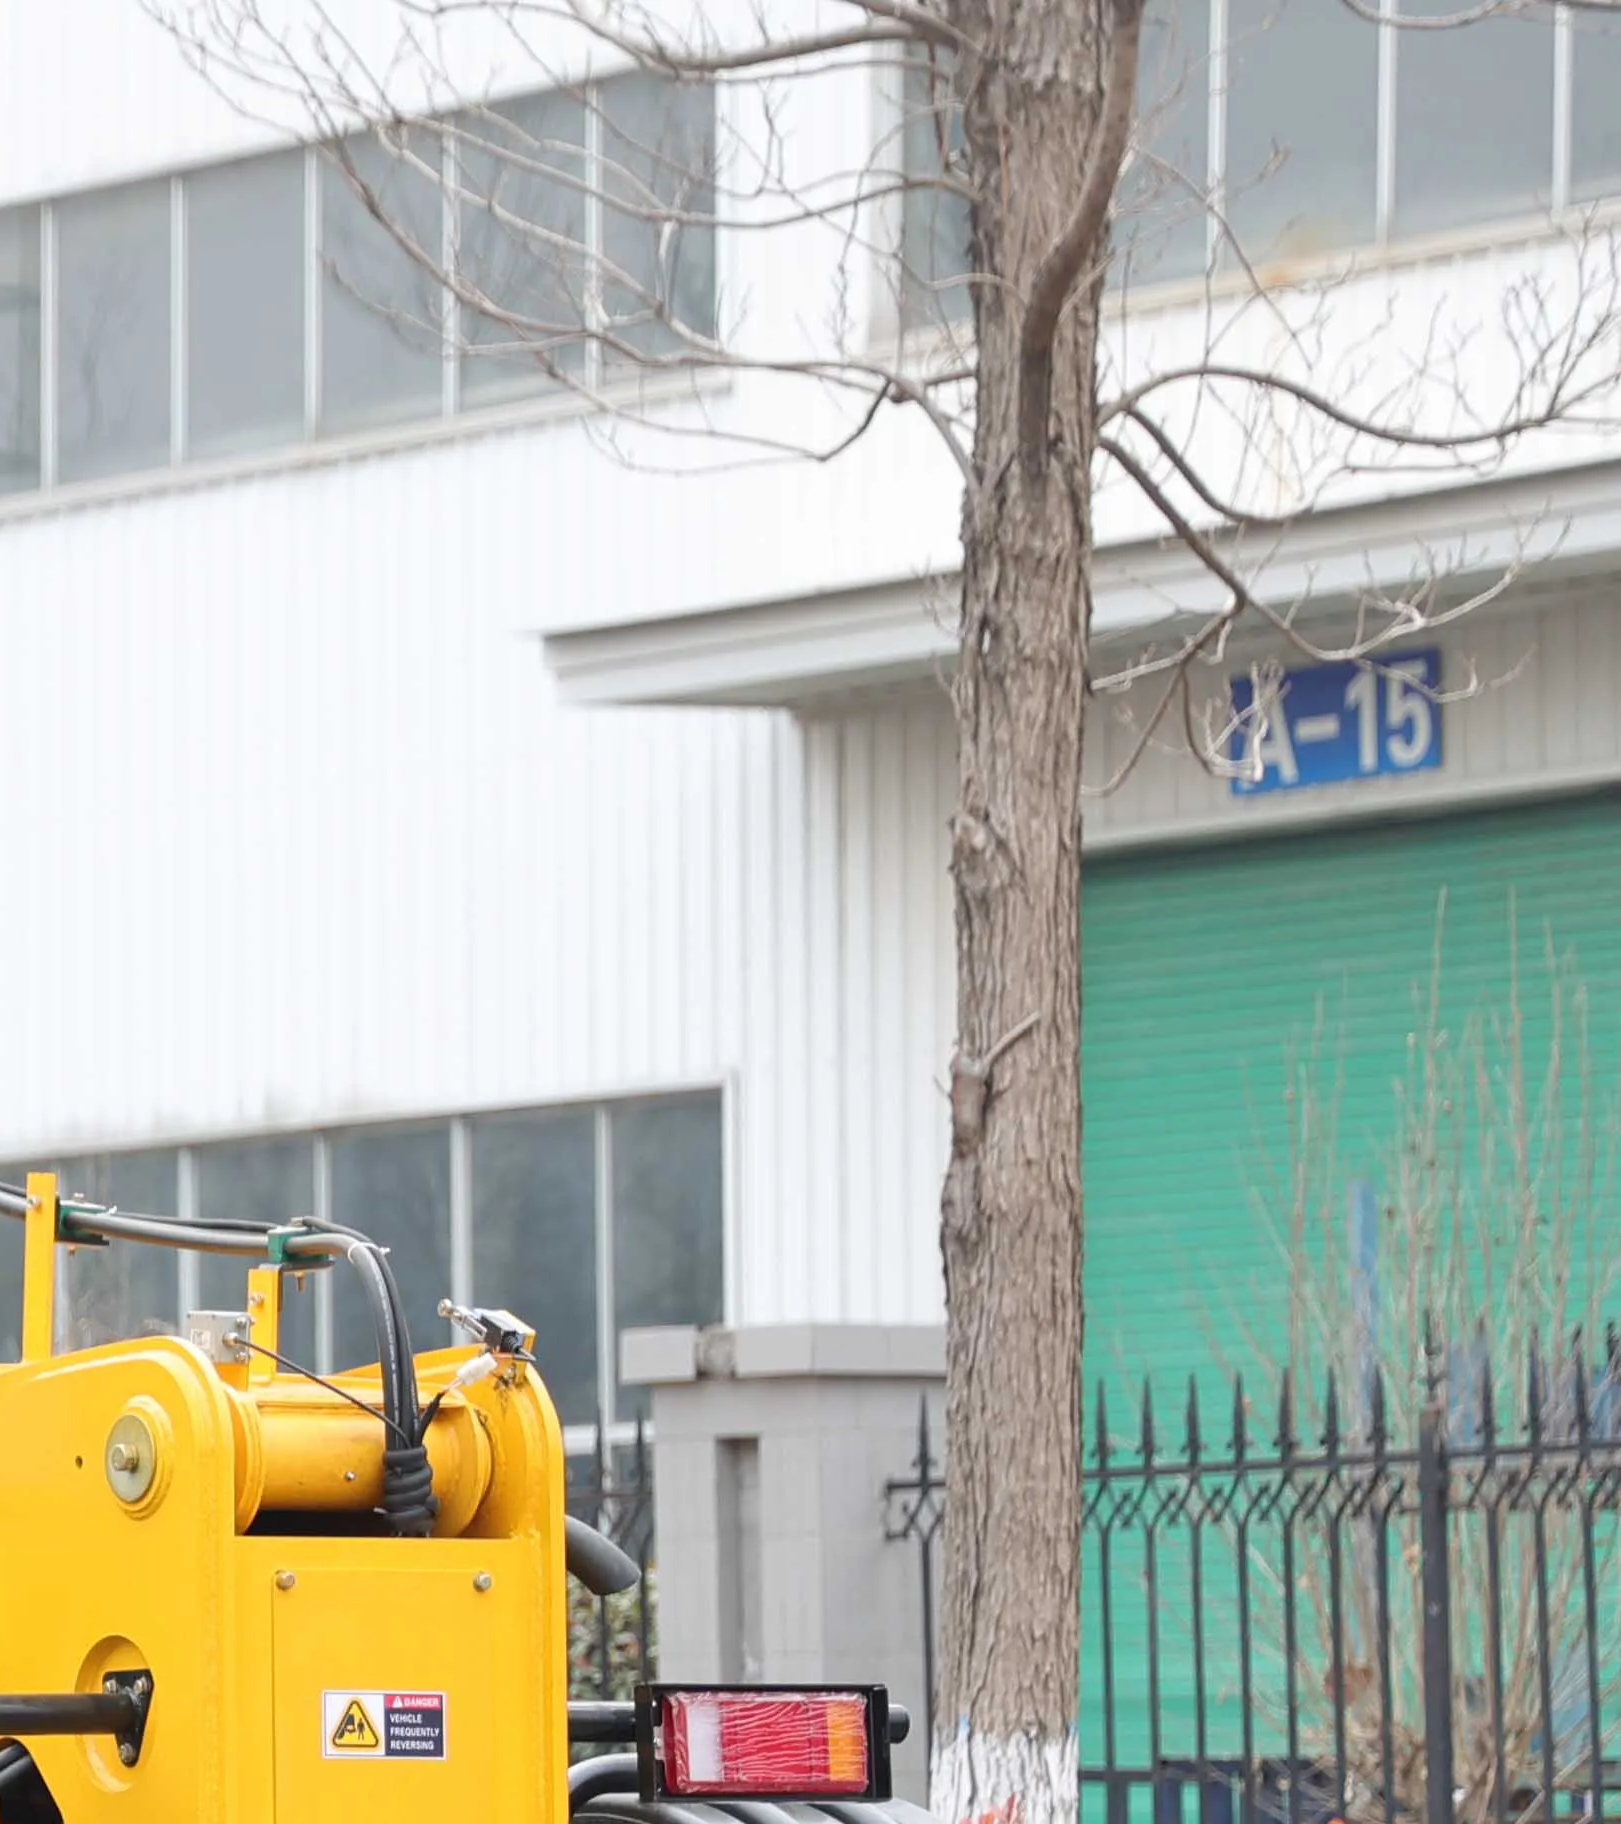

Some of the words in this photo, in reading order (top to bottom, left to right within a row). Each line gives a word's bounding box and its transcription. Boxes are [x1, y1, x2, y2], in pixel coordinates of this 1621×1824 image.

[1239, 659, 1433, 788] A-15
[403, 1696, 440, 1707] DANGER
[389, 1713, 423, 1724] VEHICLE
[390, 1726, 440, 1737] FREQUENTLY
[390, 1739, 435, 1750] REVERSING
